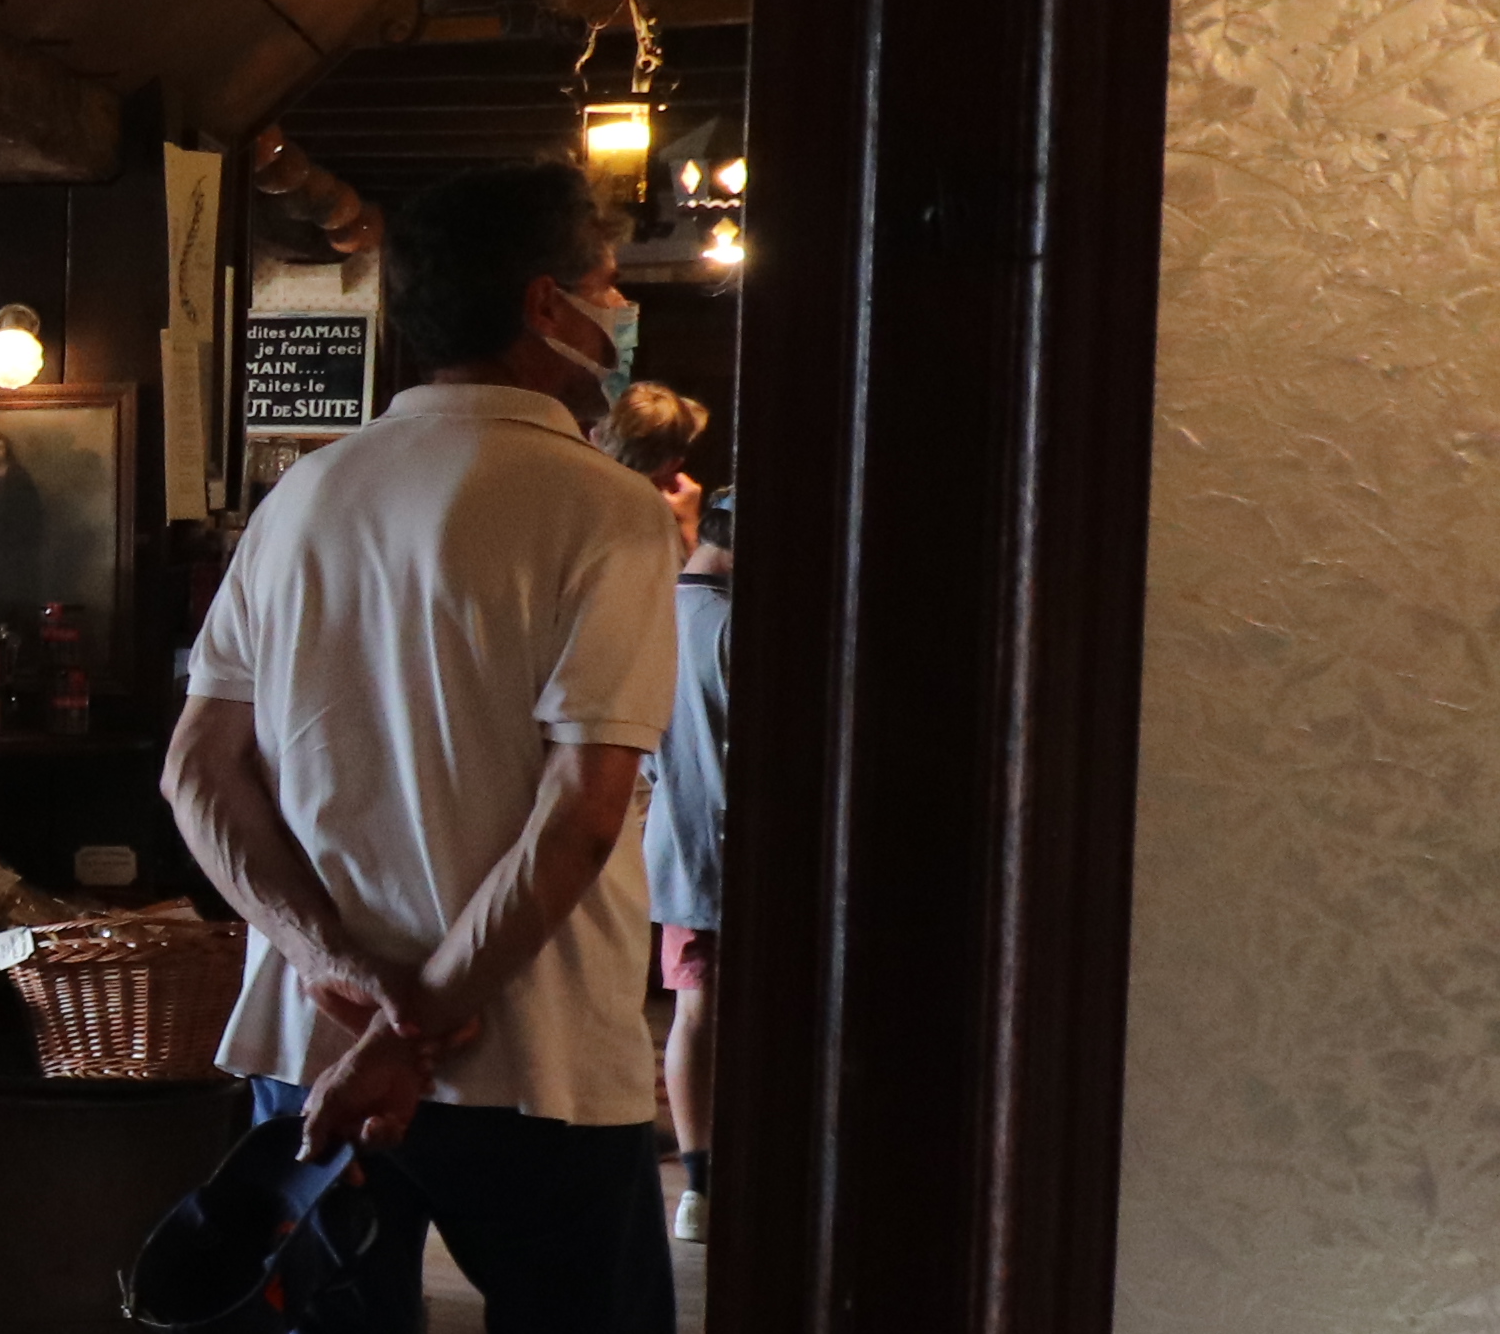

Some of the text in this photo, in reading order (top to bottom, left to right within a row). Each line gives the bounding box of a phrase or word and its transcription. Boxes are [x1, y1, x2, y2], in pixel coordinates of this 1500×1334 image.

[246, 325, 361, 339] dites JAMAIS
[254, 341, 362, 359] je ferai ceci
[247, 378, 325, 393] Faites-le
[272, 405, 291, 417] DE
[293, 398, 360, 418] SUITE
